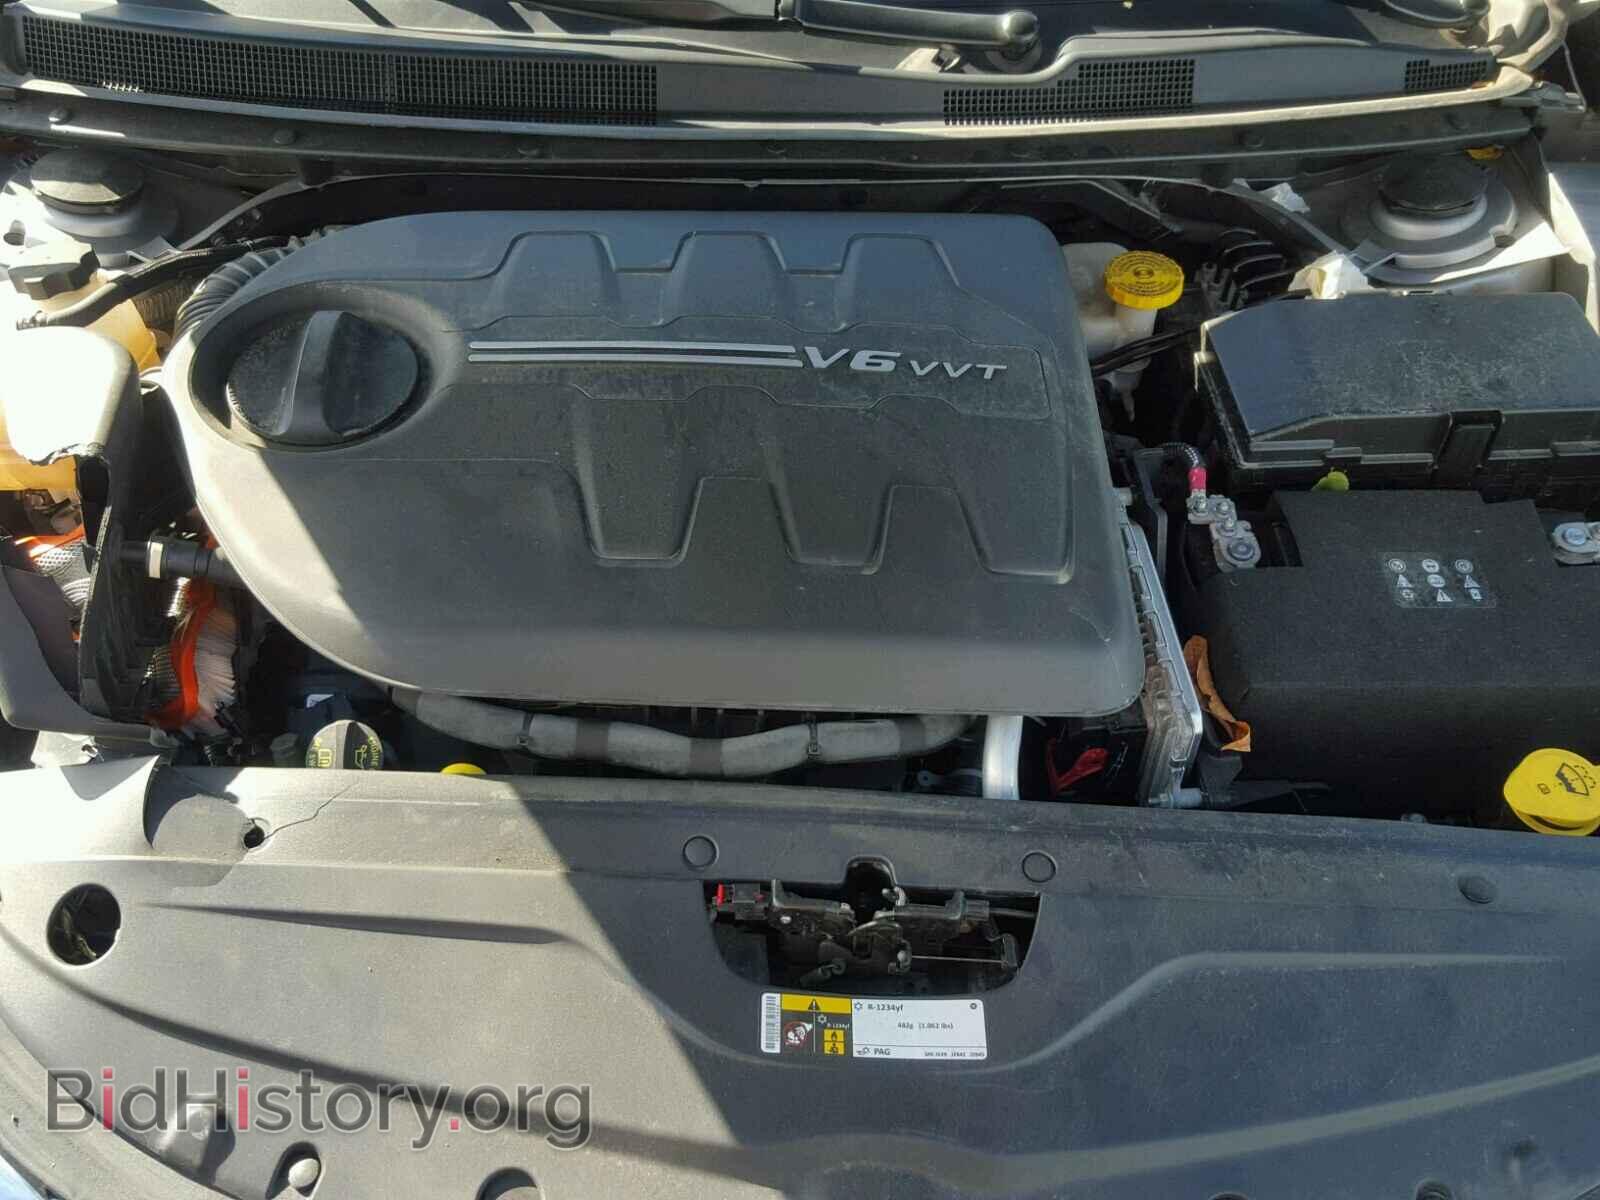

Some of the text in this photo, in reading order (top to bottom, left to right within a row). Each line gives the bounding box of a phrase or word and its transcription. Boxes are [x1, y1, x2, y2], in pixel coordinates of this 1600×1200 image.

[804, 346, 1007, 380] V6 VVT
[873, 1047, 891, 1056] PAG
